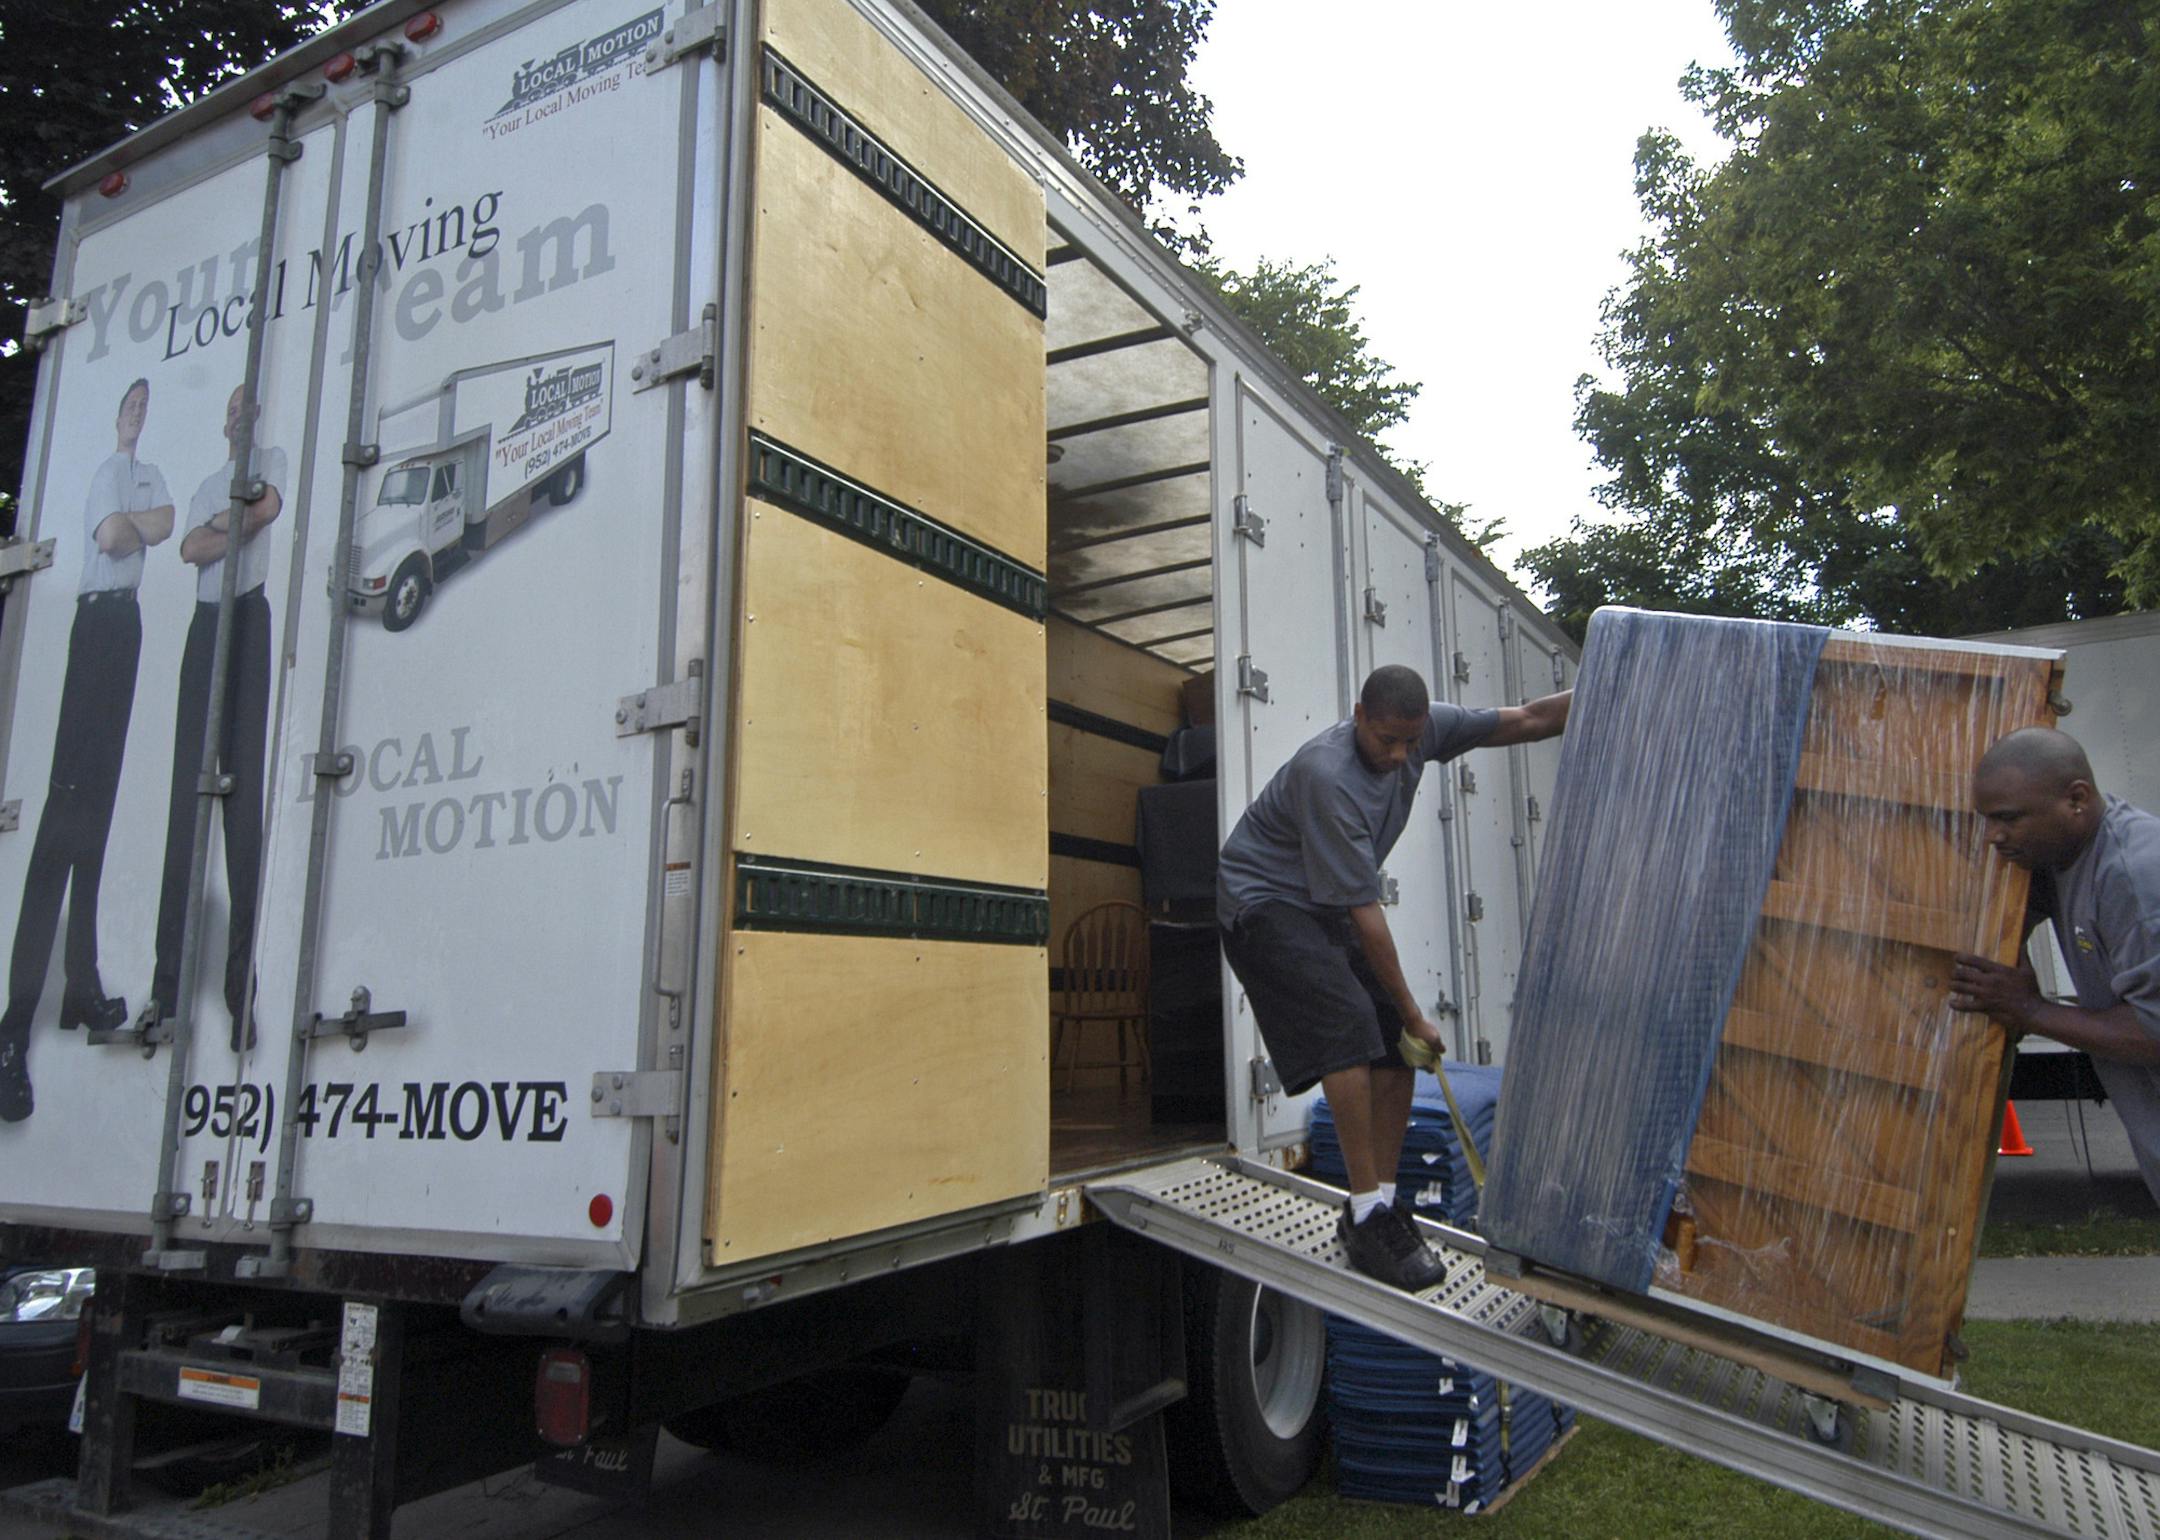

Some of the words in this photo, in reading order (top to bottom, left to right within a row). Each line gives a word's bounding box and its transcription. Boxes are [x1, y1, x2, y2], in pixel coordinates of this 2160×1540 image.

[520, 57, 576, 94] LOCAL
[587, 15, 660, 63] MOTION
[525, 95, 562, 125] Local
[566, 73, 621, 108] Moving
[301, 190, 503, 310] Moving
[80, 237, 261, 363] Your
[530, 380, 567, 410] LOCAL
[525, 448, 551, 480] (952)
[553, 425, 592, 457] 474-MOVE
[531, 422, 556, 452] Local
[556, 412, 582, 438] Moving
[295, 726, 484, 803] LOCAL
[375, 775, 624, 860] MOTION
[182, 1082, 275, 1154] 952)
[298, 1081, 568, 1142] 474-MOVE
[1008, 1423, 1132, 1465] UTILITIES
[1038, 1464, 1052, 1484] &
[1062, 1495, 1136, 1531] Paul
